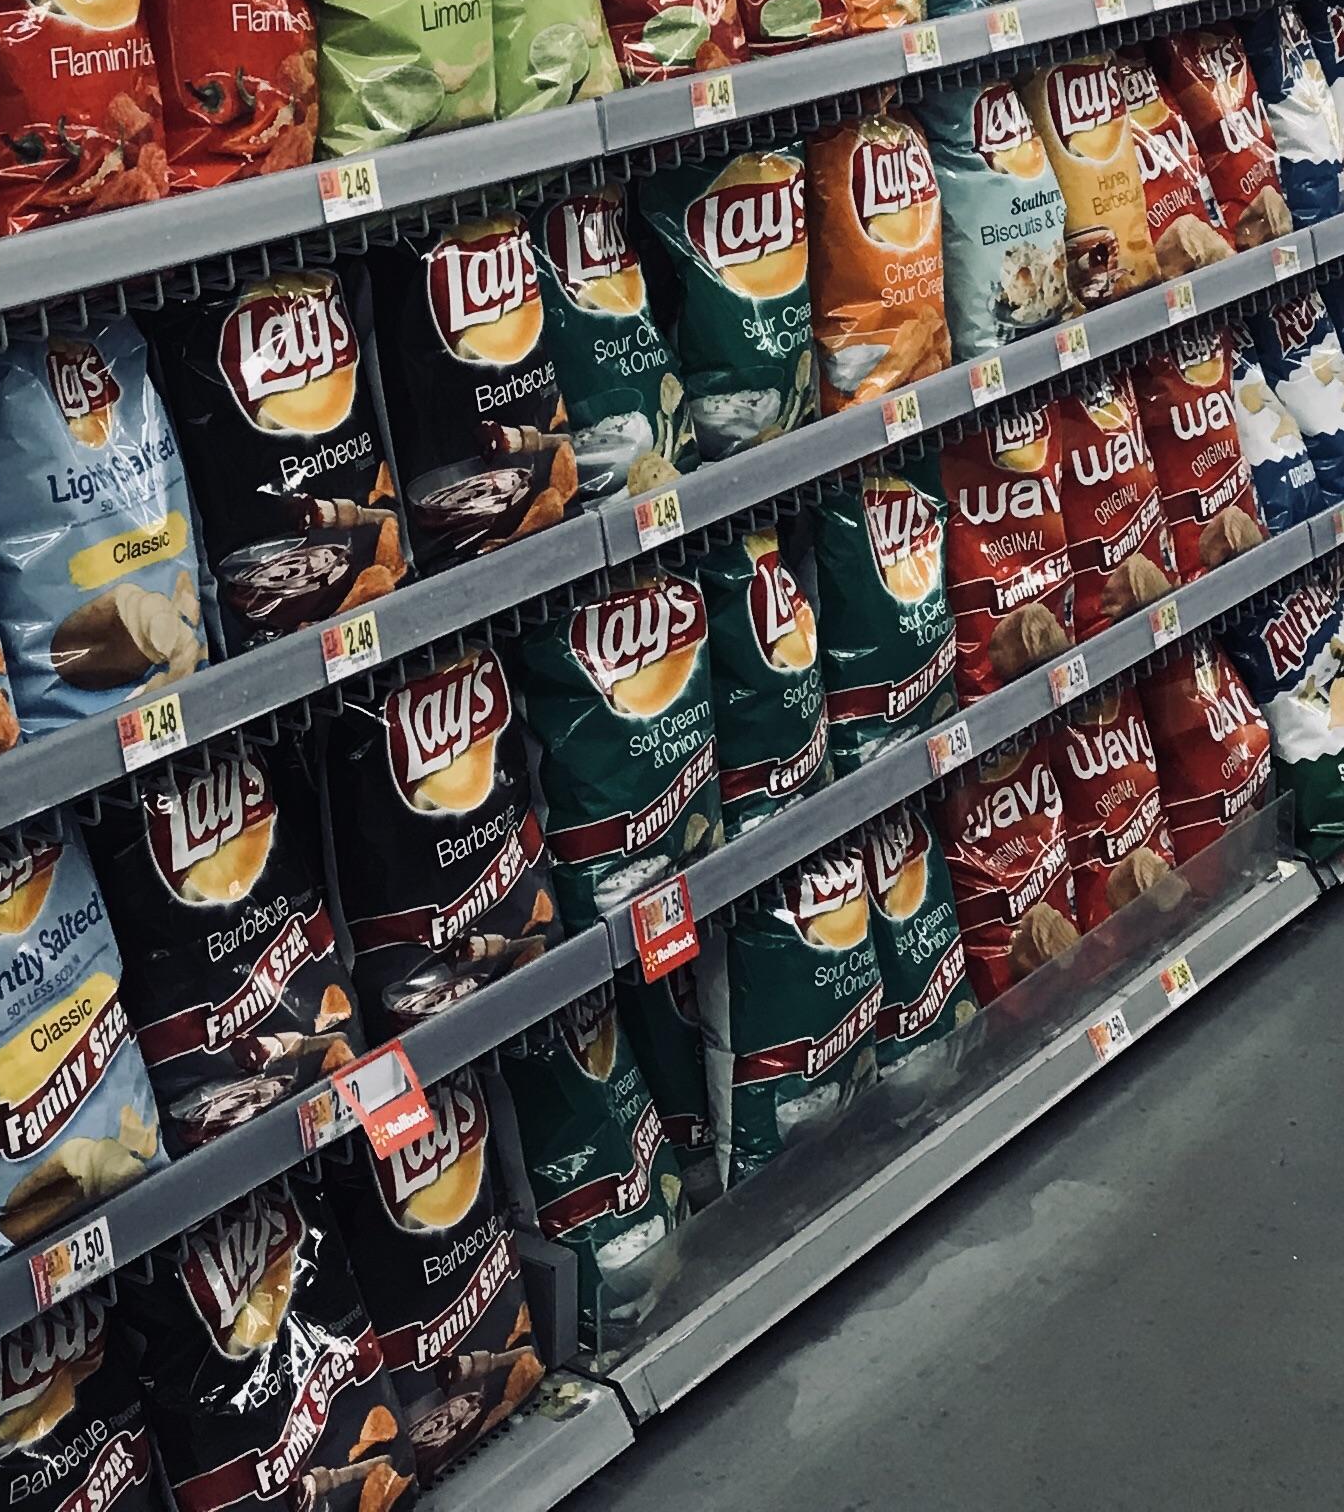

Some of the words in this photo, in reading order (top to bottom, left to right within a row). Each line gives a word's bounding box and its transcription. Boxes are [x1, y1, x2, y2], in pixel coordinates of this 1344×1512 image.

[1097, 170, 1131, 191] Honey
[981, 218, 1042, 246] Biscuits
[1045, 210, 1055, 228] &
[1147, 186, 1196, 228] ORIGINAL
[884, 255, 939, 286] Cheddar
[880, 283, 911, 308] Sour
[594, 337, 630, 362] Sour
[742, 310, 775, 341] Sour
[476, 360, 556, 413] Barbecue
[280, 431, 373, 482] Barbecue
[1192, 438, 1236, 477] ORIGINAL
[1095, 484, 1140, 525] ORIGINAL
[1201, 478, 1239, 517] Family
[112, 532, 170, 565] Classic
[985, 531, 1045, 567] ORIGINAL
[1104, 522, 1141, 566] Family
[887, 662, 932, 717] Family
[629, 727, 658, 757] Sour
[659, 698, 710, 735] Cream
[1067, 716, 1155, 779] wavy
[625, 789, 681, 852] Family
[680, 748, 714, 800] Size!
[962, 764, 1063, 844] wavy
[1095, 780, 1139, 818] ORIGINAL
[437, 803, 516, 868] Barbecue
[1107, 819, 1144, 858] Family
[431, 877, 500, 951] Family
[1009, 872, 1043, 917] Family
[39, 893, 103, 962] Salted
[208, 892, 289, 962] Barbecue
[918, 902, 952, 936] Cream
[658, 933, 694, 961] Rollback
[26, 980, 53, 1008] LESS
[205, 970, 274, 1045] Family
[268, 921, 308, 986] Size!
[30, 997, 93, 1053] Classic
[899, 982, 941, 1037] Family
[807, 1013, 857, 1077] Family
[5, 1055, 87, 1154] Family
[386, 1105, 429, 1138] Rollback
[423, 1215, 498, 1284] Barbecue
[417, 1294, 476, 1365] Family
[478, 1246, 509, 1297] Size!
[256, 1425, 311, 1494] Family
[309, 1351, 353, 1420] Size!
[9, 1418, 108, 1503] Barbecue
